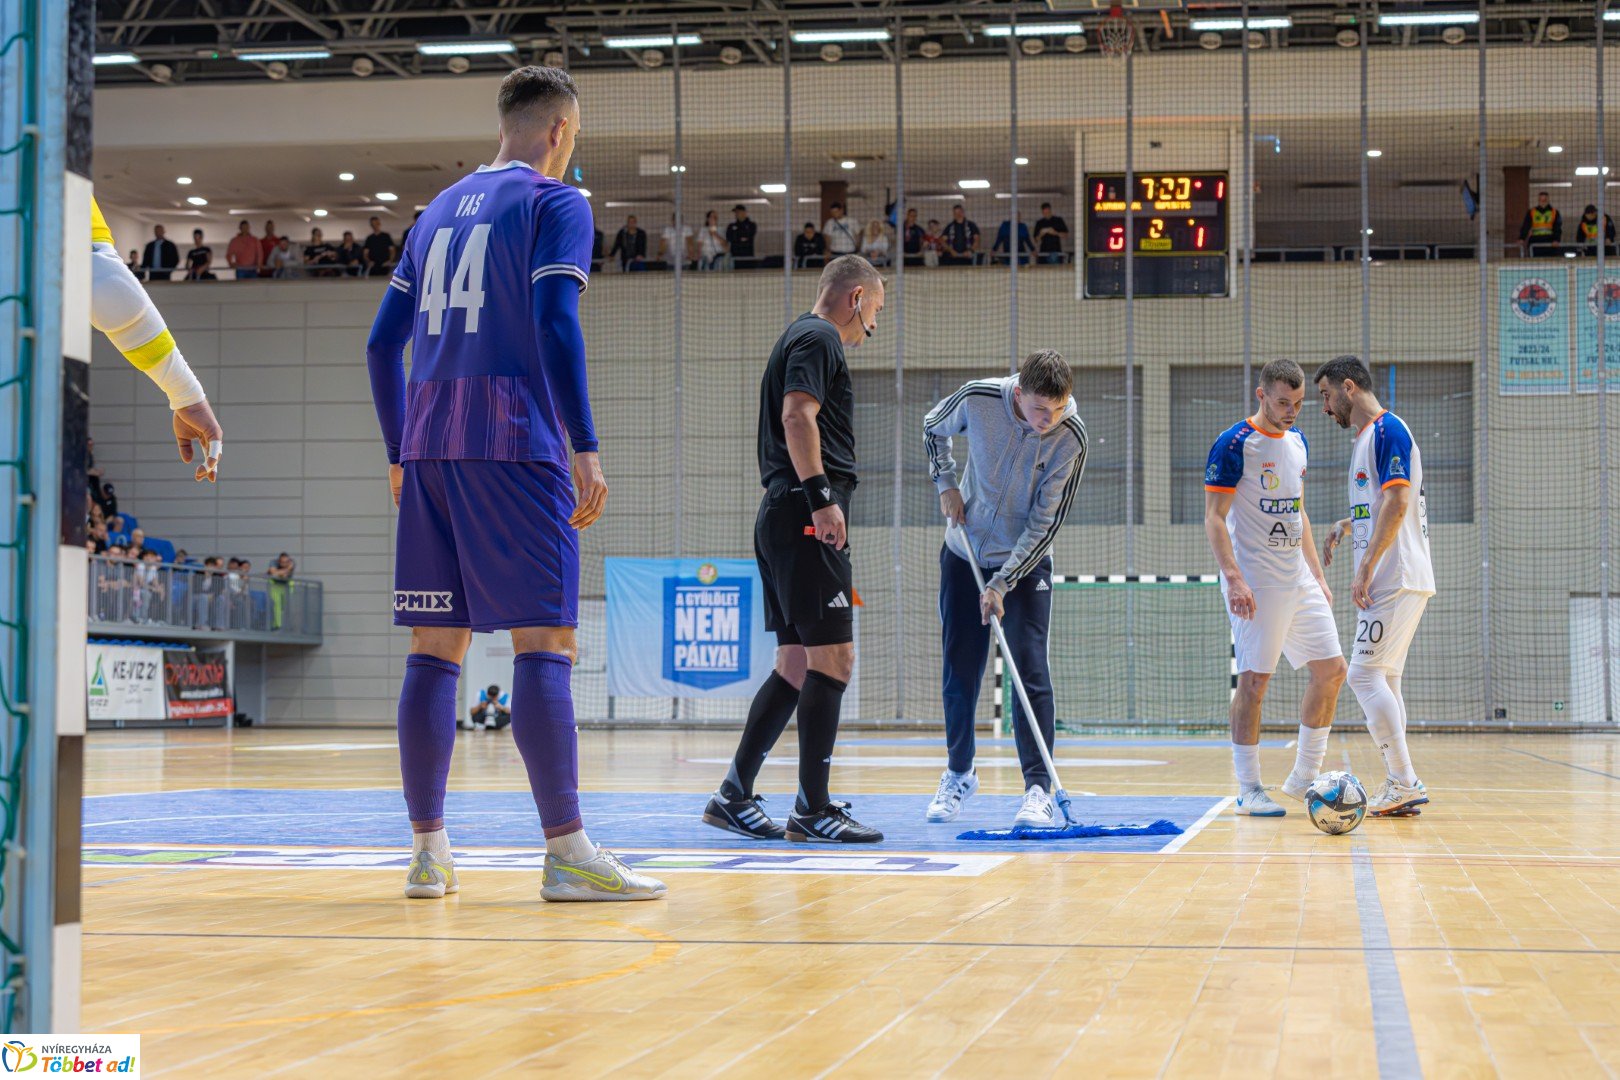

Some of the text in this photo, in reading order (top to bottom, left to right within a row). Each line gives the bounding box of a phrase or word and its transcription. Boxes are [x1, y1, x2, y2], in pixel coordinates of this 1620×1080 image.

[455, 192, 485, 217] VAS
[419, 223, 492, 335] 44
[675, 592, 685, 606] A
[675, 607, 740, 641] NEM
[1357, 620, 1384, 643] 20
[674, 641, 739, 667] PÁLYA!
